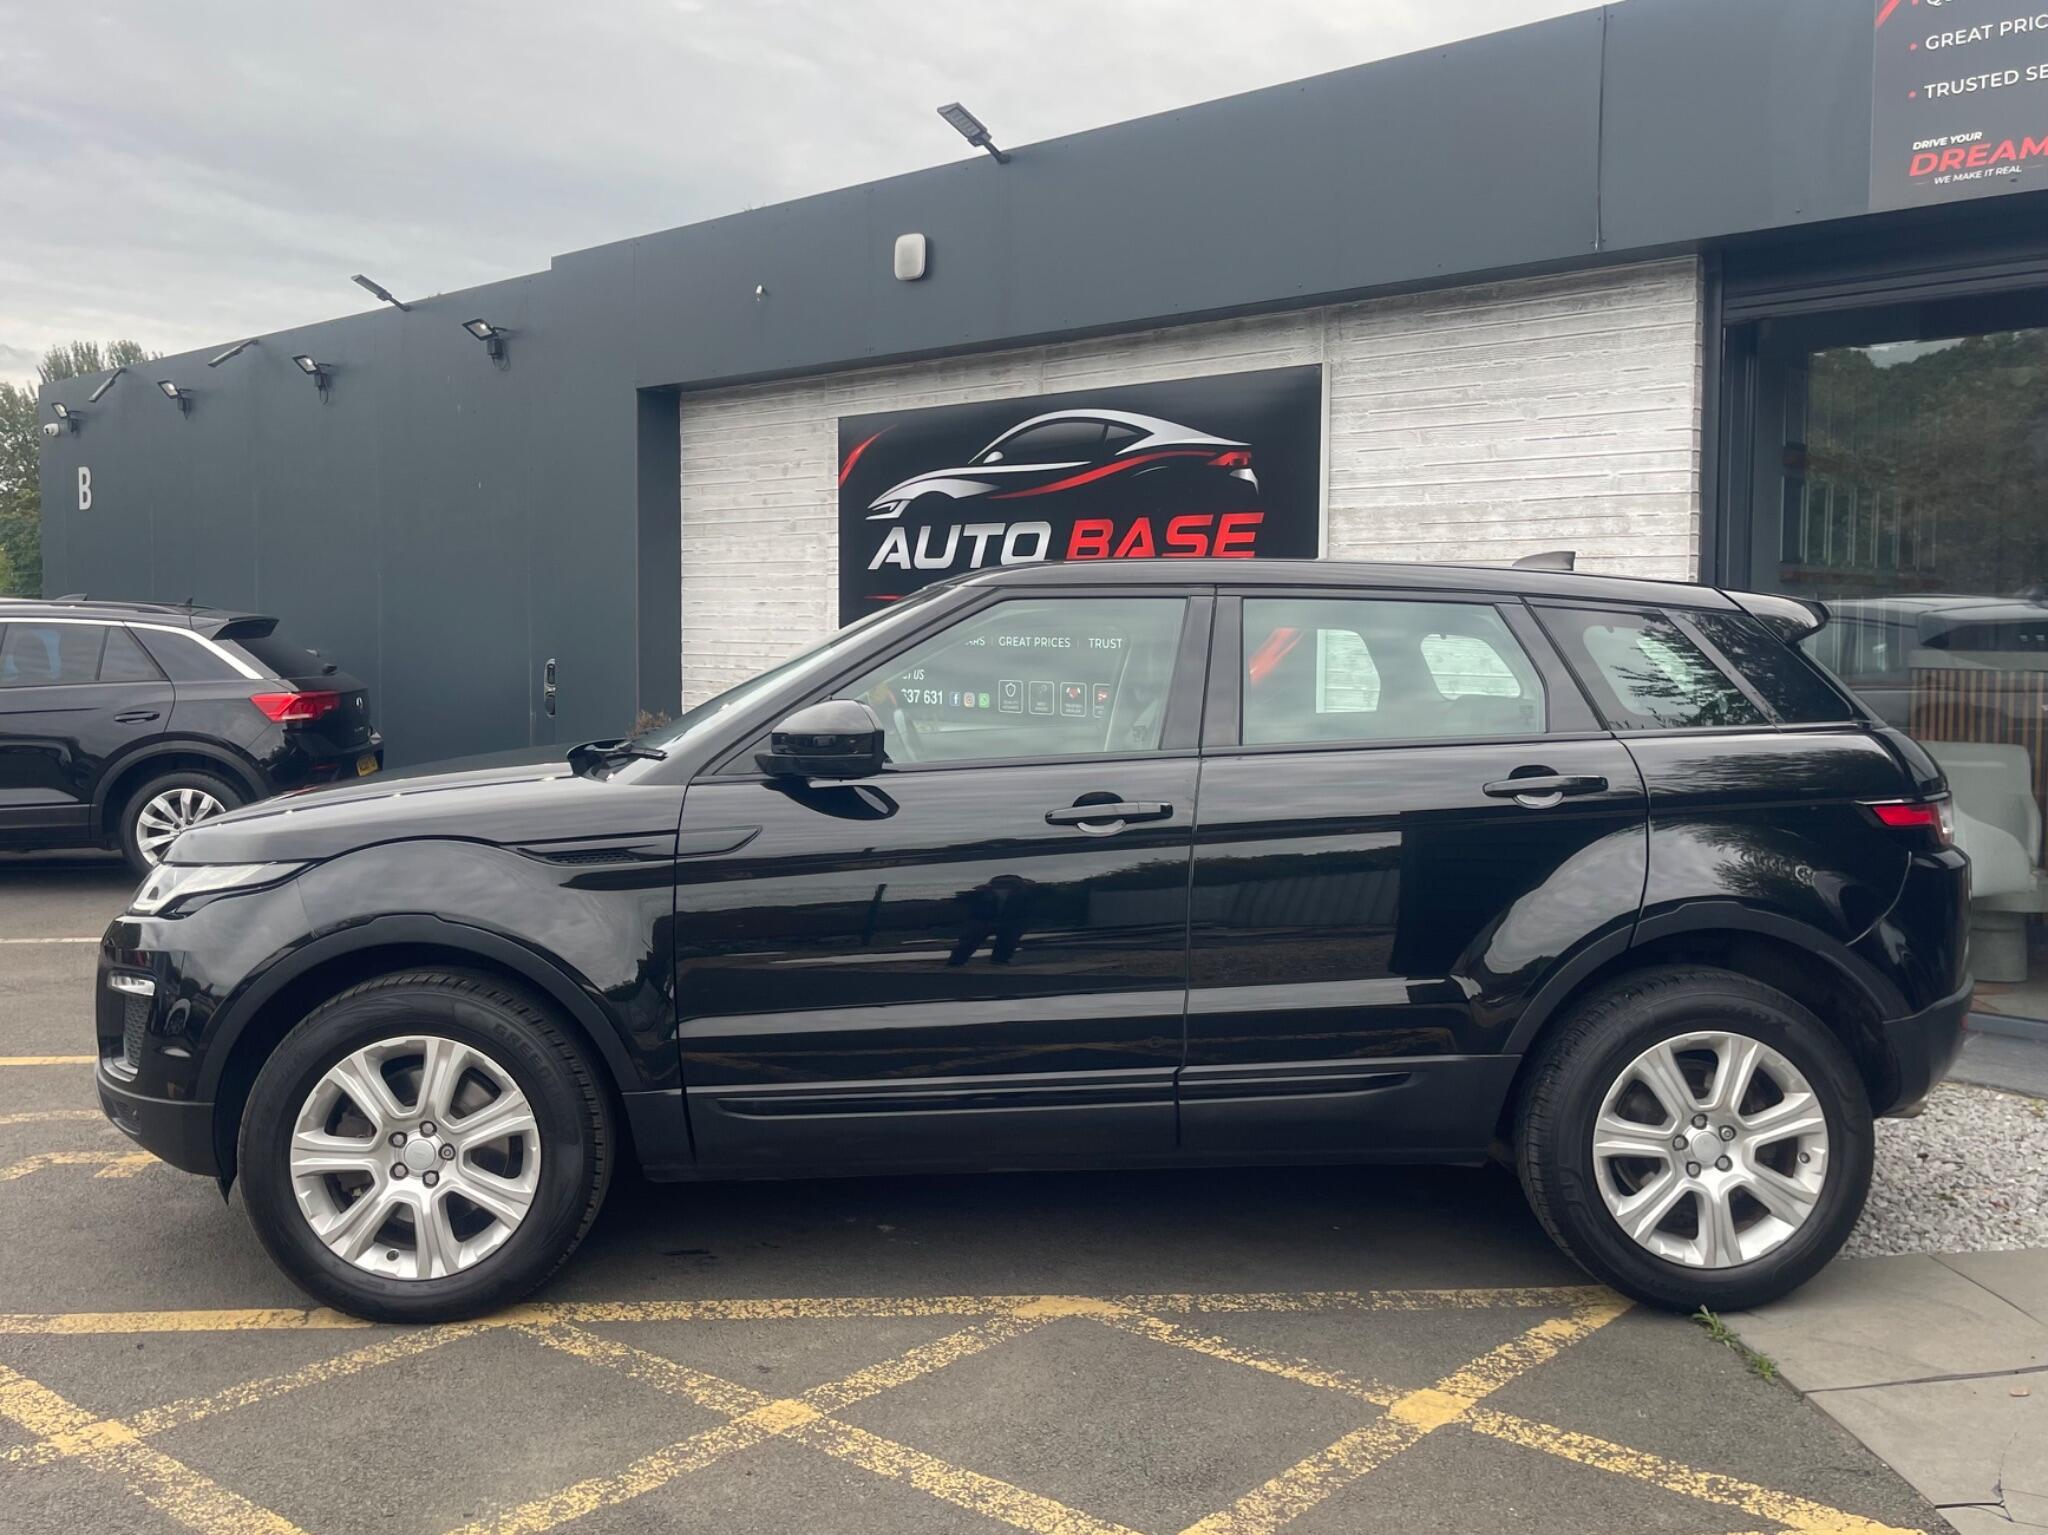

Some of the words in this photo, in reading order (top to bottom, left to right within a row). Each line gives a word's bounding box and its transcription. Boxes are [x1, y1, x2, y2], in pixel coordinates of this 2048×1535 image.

[1925, 25, 1993, 50] GREAT
[1924, 69, 2019, 98] TRUSTED
[1912, 136, 1948, 150] DRIVE
[1950, 131, 1983, 145] YOUR
[1909, 135, 2048, 176] DREAM
[1934, 176, 1951, 185] WE
[1953, 170, 1983, 182] MAKE
[1984, 168, 1995, 177] IT
[1995, 165, 2022, 176] REAL
[78, 466, 92, 510] B
[867, 521, 1052, 570] AUTO
[1065, 512, 1265, 560] BASE
[998, 636, 1032, 647] GREAT
[1034, 637, 1071, 648] PRICES
[1088, 638, 1122, 649] TRUST
[913, 669, 925, 680] US
[923, 690, 943, 705] 631
